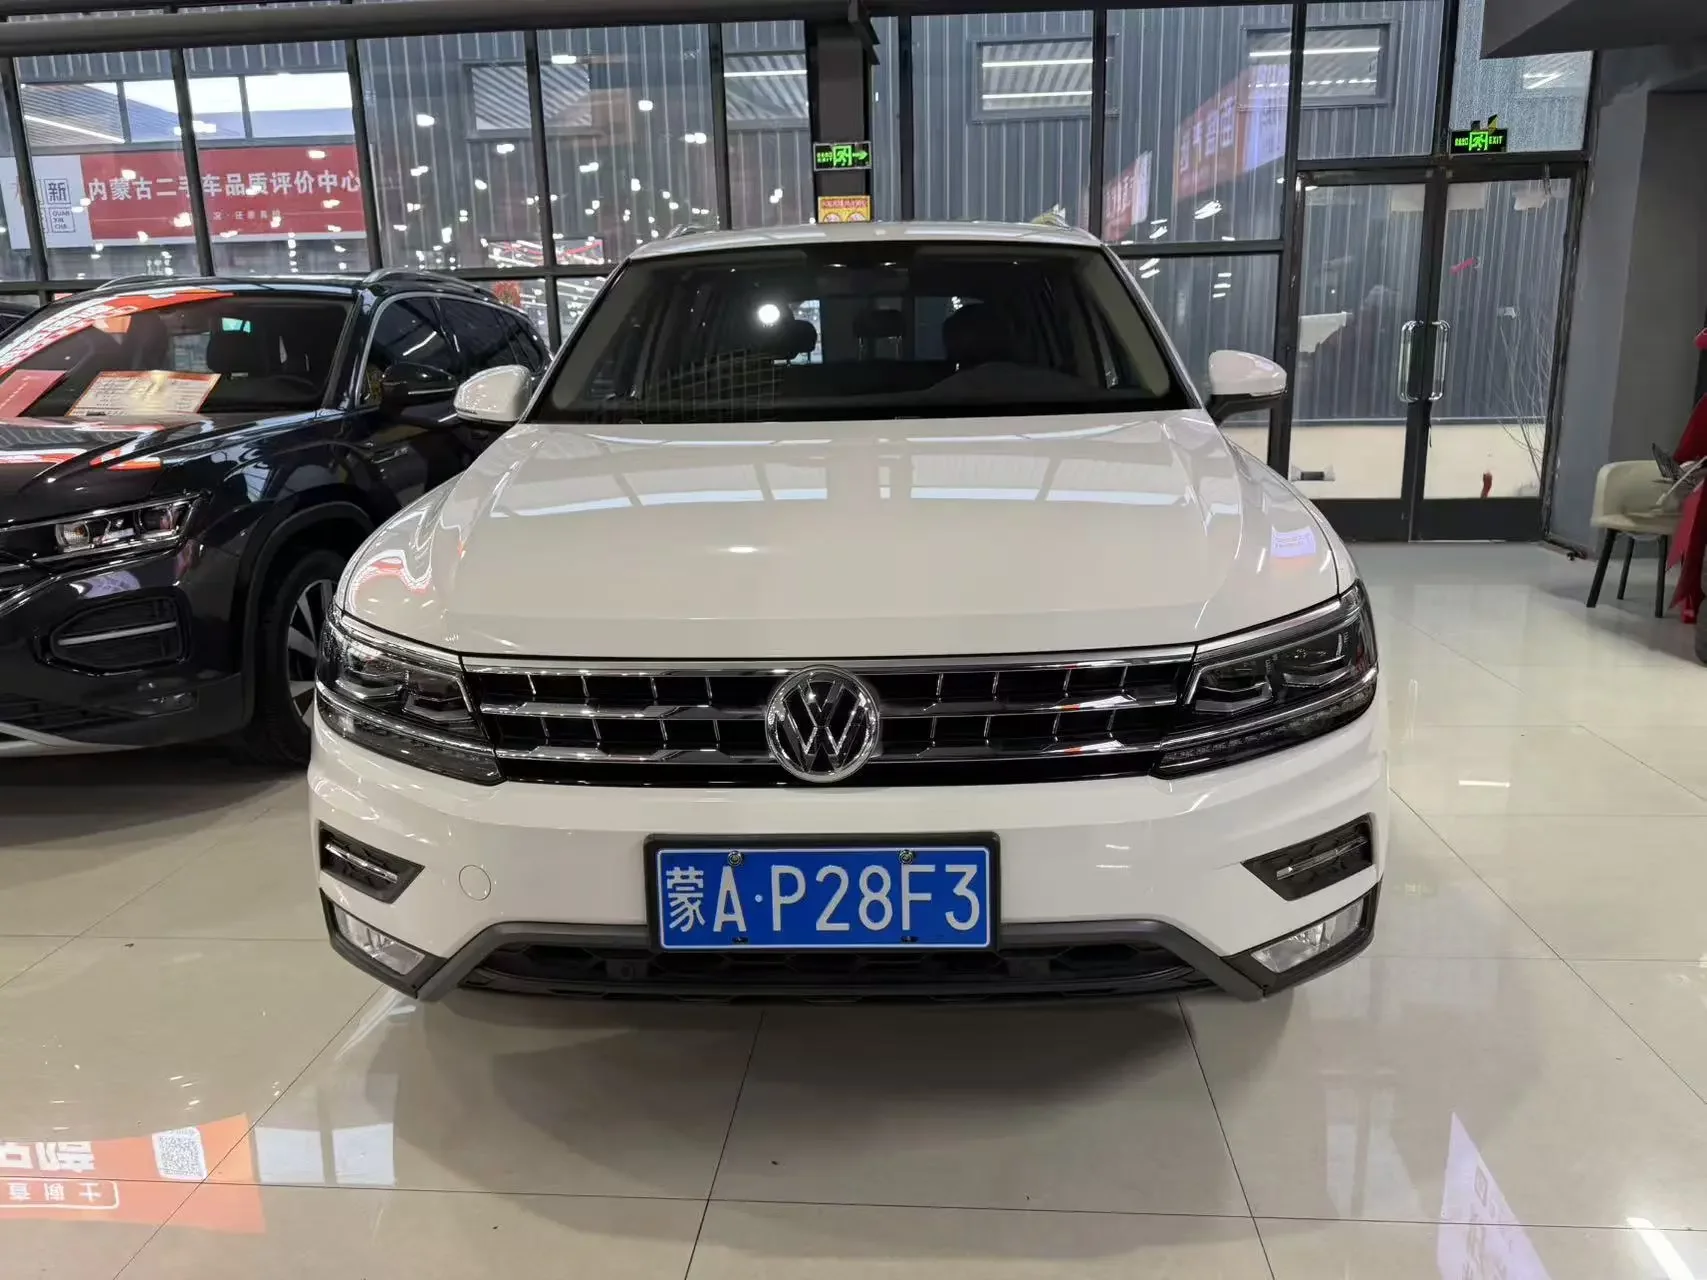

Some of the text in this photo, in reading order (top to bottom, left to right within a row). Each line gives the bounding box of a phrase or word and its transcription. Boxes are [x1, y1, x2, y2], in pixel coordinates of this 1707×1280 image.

[1489, 136, 1503, 145] EXIT
[48, 183, 67, 201] 新
[773, 673, 871, 777] VW
